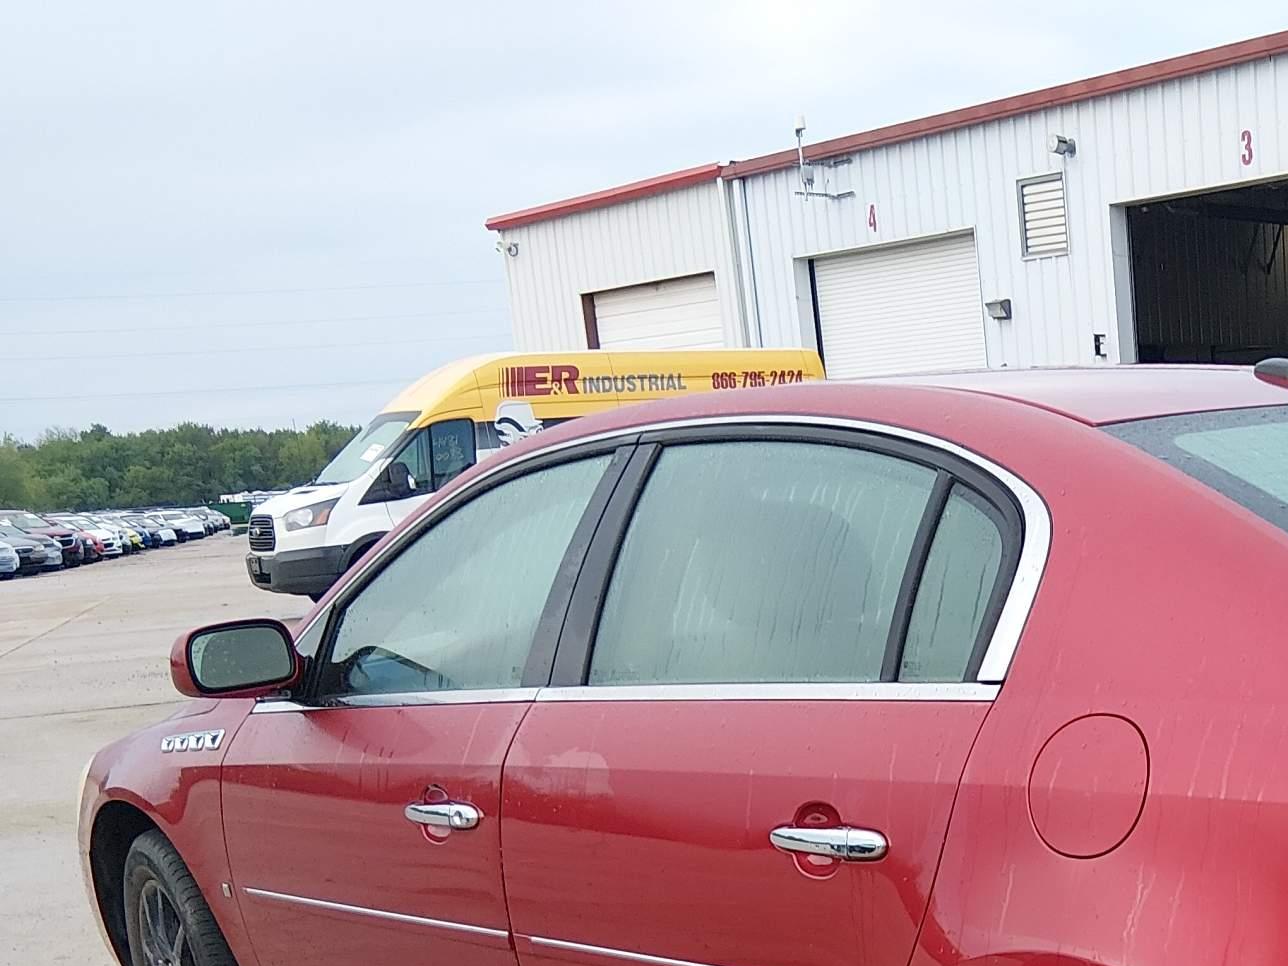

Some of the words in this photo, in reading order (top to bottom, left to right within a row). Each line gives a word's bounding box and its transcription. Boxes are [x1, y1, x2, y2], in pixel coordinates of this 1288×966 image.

[1240, 129, 1254, 166] 3
[868, 203, 877, 233] 4
[582, 372, 687, 395] INDUSTRIAL
[711, 369, 803, 390] 866-795-2424
